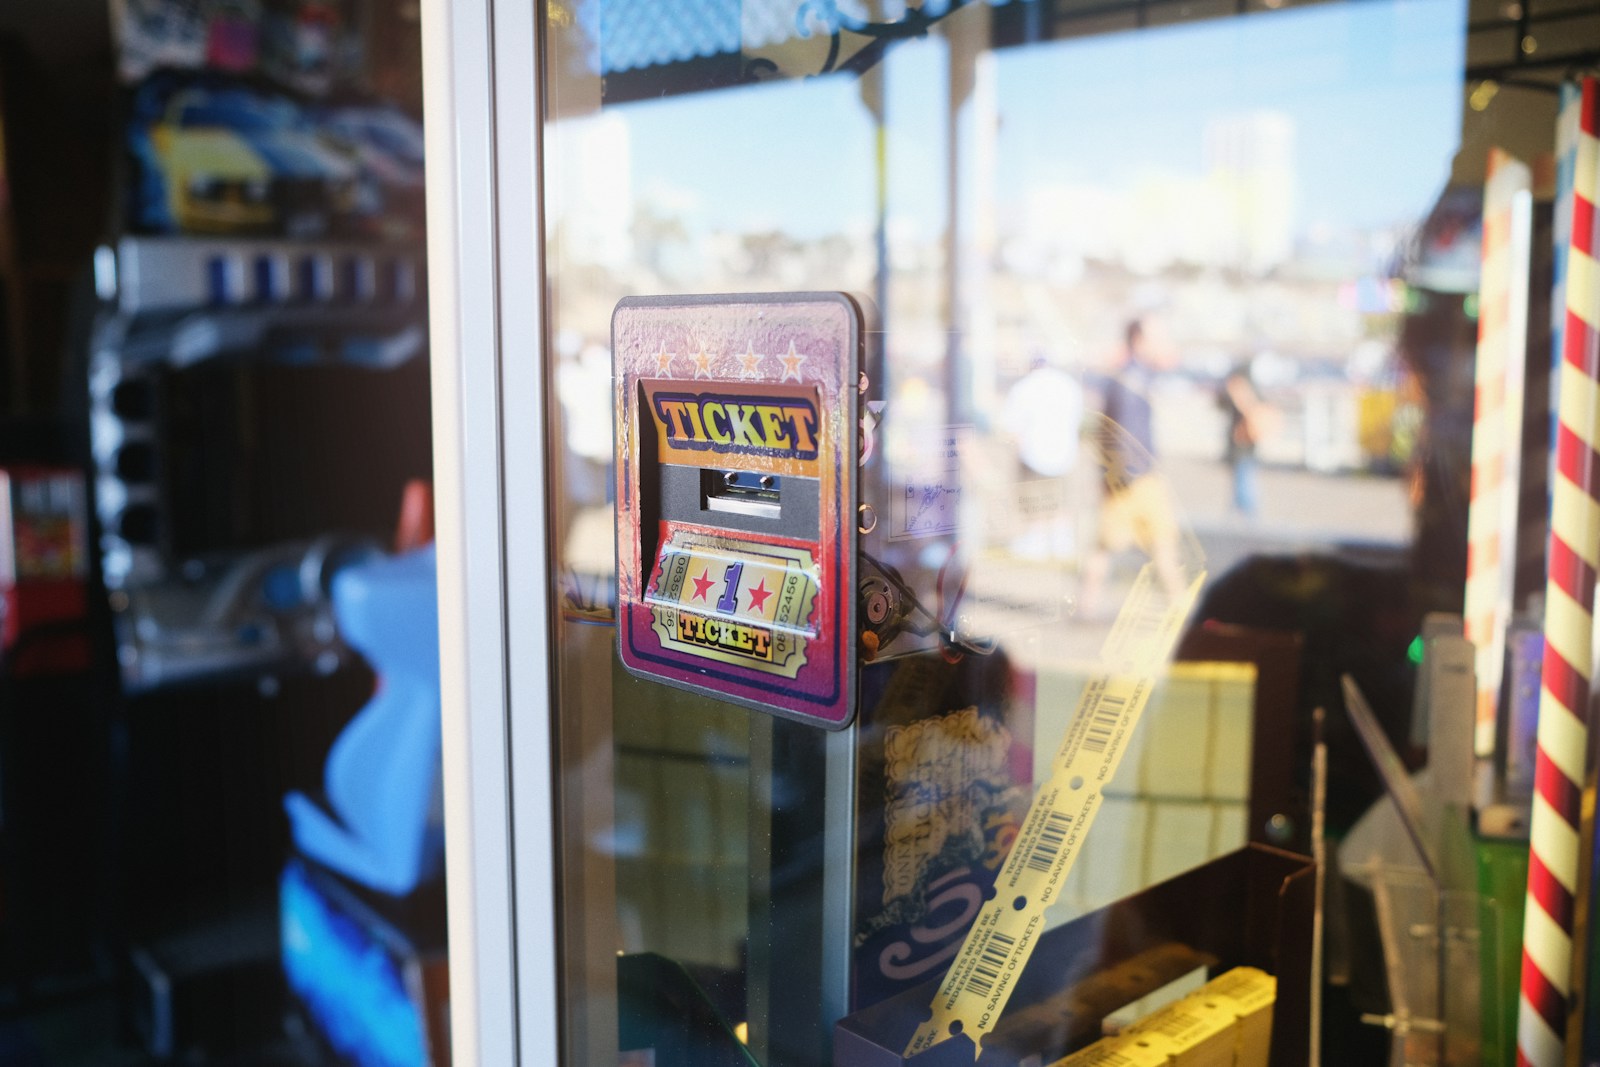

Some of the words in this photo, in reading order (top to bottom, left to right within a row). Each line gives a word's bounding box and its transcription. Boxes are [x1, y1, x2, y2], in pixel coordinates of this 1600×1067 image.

[658, 397, 818, 455] TICKET
[716, 561, 744, 615] 1
[778, 575, 798, 652] 0852456
[679, 613, 771, 658] TICKET
[1097, 767, 1108, 781] NO
[1104, 729, 1125, 764] SAVING
[1006, 838, 1028, 874] TICKETS
[1025, 808, 1041, 835] MUST
[1039, 794, 1048, 806] BE
[1009, 837, 1037, 887] REDEEMED
[1035, 808, 1050, 835] SAME
[1041, 886, 1053, 903] NO
[1049, 848, 1071, 885] SAVING
[1067, 833, 1077, 846] OF
[943, 958, 967, 997] TICKETS
[965, 928, 983, 956] MUST
[981, 913, 991, 926] BE
[945, 957, 977, 1010] REDEEMED
[975, 928, 992, 956] SAME
[977, 1012, 990, 1029] NO
[987, 973, 1011, 1011] SAVING
[1007, 956, 1018, 971] OF
[1015, 914, 1040, 958] TICKETS.
[914, 1035, 926, 1049] BE
